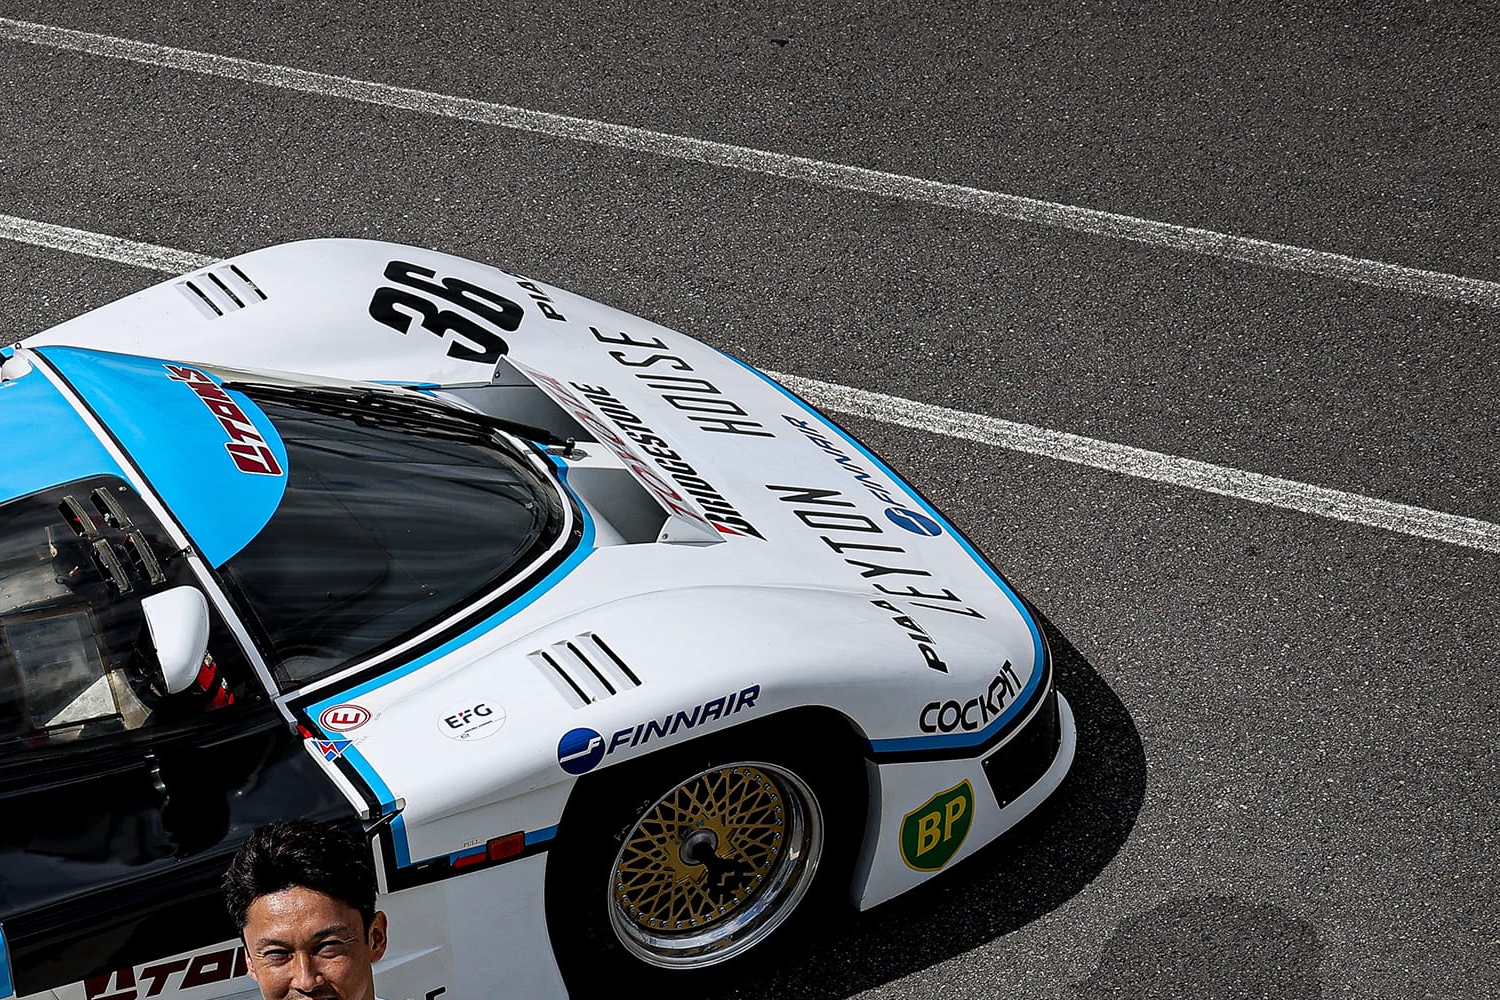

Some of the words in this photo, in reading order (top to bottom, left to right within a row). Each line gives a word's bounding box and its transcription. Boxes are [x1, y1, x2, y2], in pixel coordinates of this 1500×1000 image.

[369, 260, 525, 365] 36
[589, 326, 777, 438] HOUSE
[569, 381, 768, 542] BRIDGESTONE
[781, 414, 907, 508] FINNAIR
[765, 484, 987, 619] LEYTON
[869, 600, 949, 674] PIAA
[444, 703, 493, 729] EFG
[607, 684, 760, 755] FINNAIR
[918, 659, 1022, 733] COCKPIT
[916, 796, 966, 858] BP
